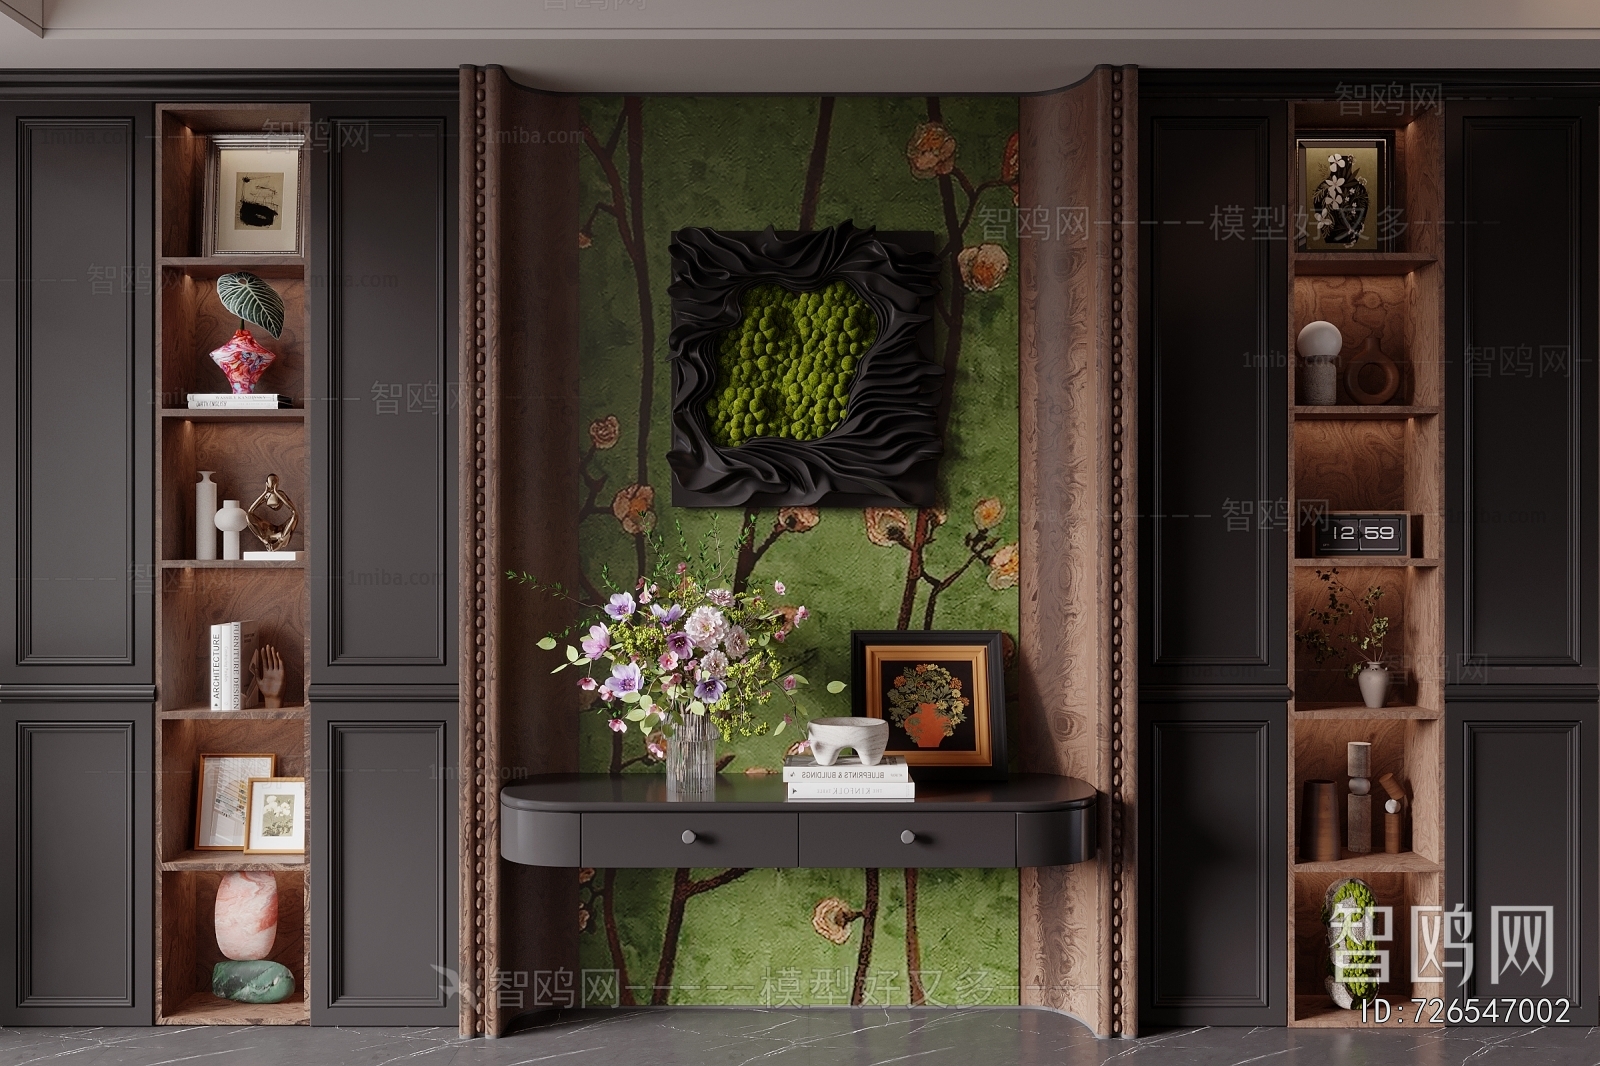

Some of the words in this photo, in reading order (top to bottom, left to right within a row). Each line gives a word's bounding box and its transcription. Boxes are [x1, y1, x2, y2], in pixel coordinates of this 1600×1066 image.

[1333, 526, 1355, 540] 12
[1364, 526, 1395, 540] 59
[212, 633, 220, 700] ARCHITECTURE
